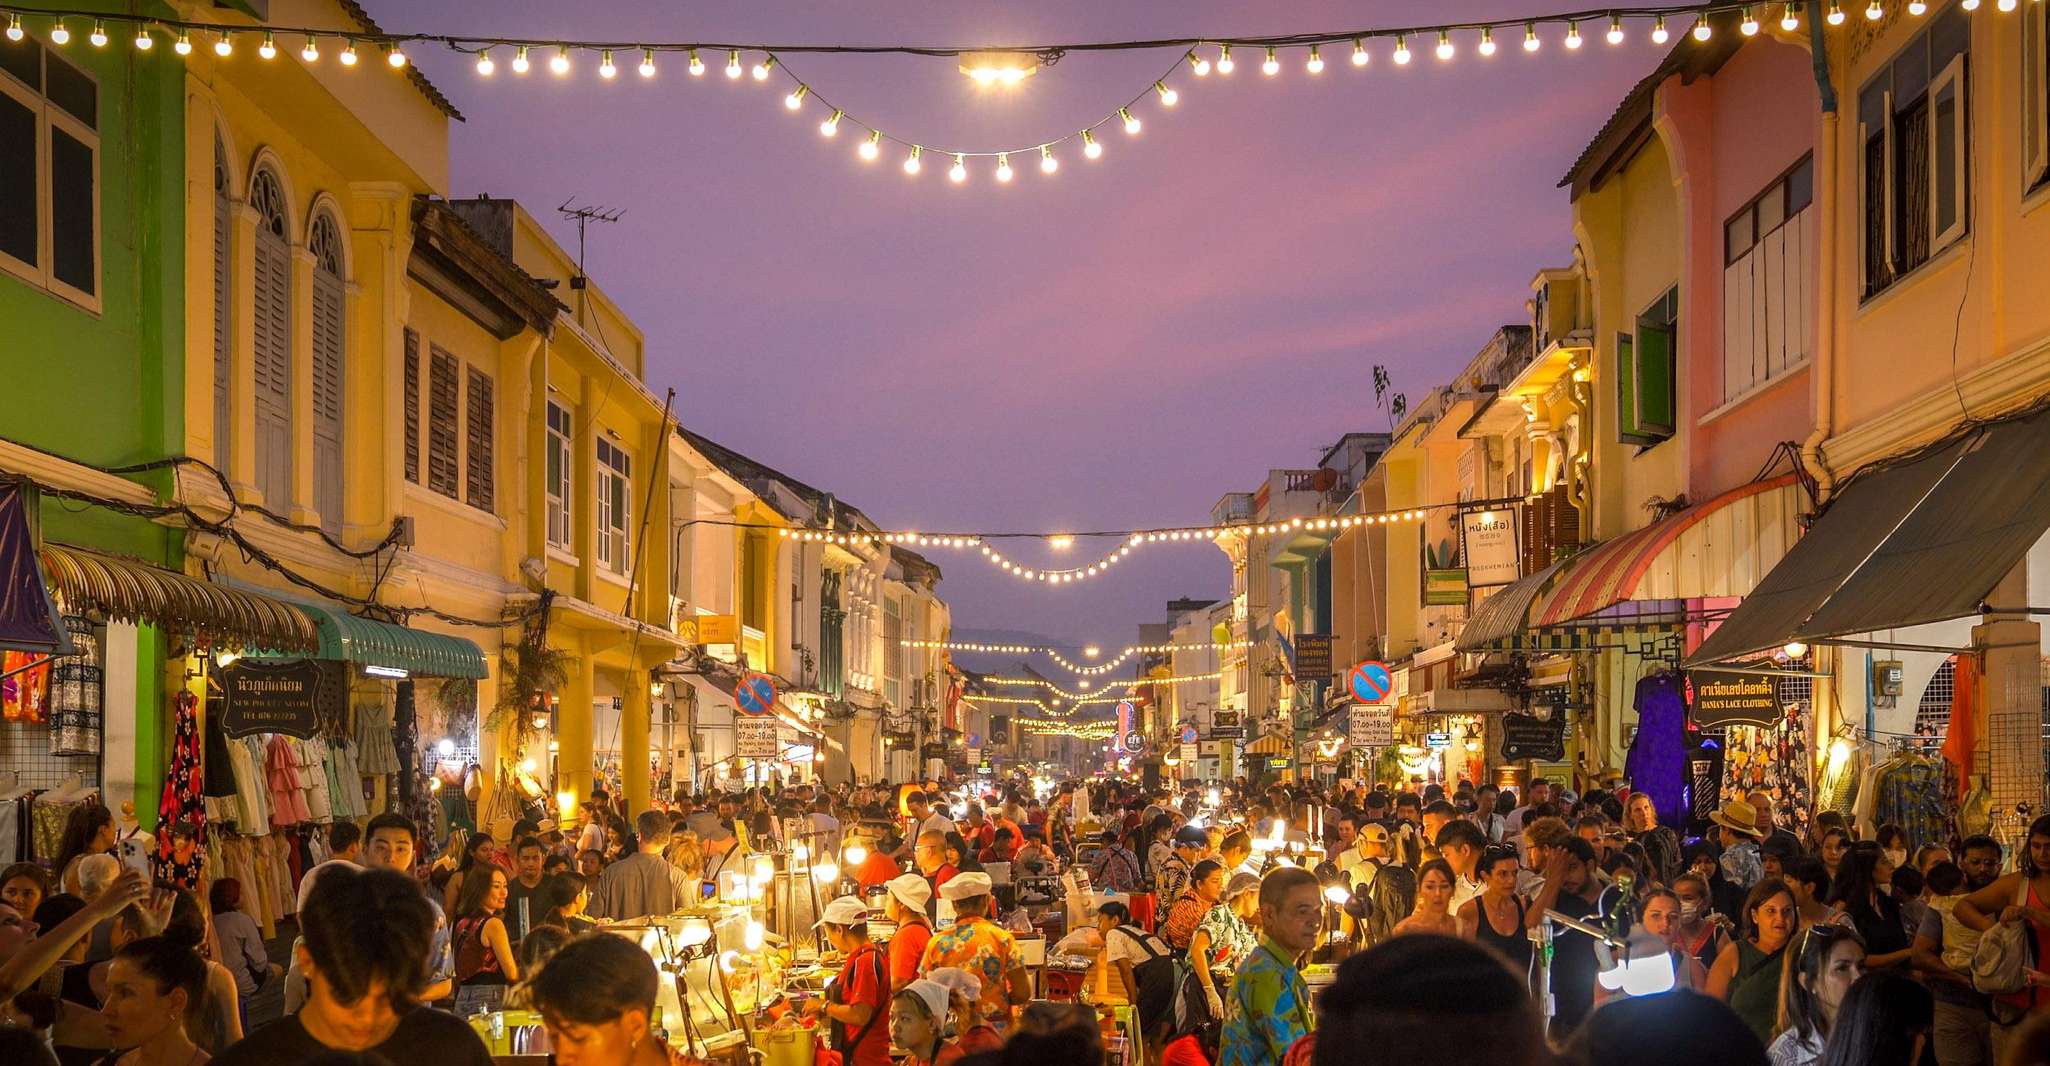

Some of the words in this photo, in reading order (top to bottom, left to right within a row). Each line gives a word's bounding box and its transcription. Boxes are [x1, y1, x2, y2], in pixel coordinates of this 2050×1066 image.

[1701, 700, 1725, 709] DANIA'S
[1726, 699, 1741, 708] LACE
[1742, 698, 1773, 708] CLOTHING
